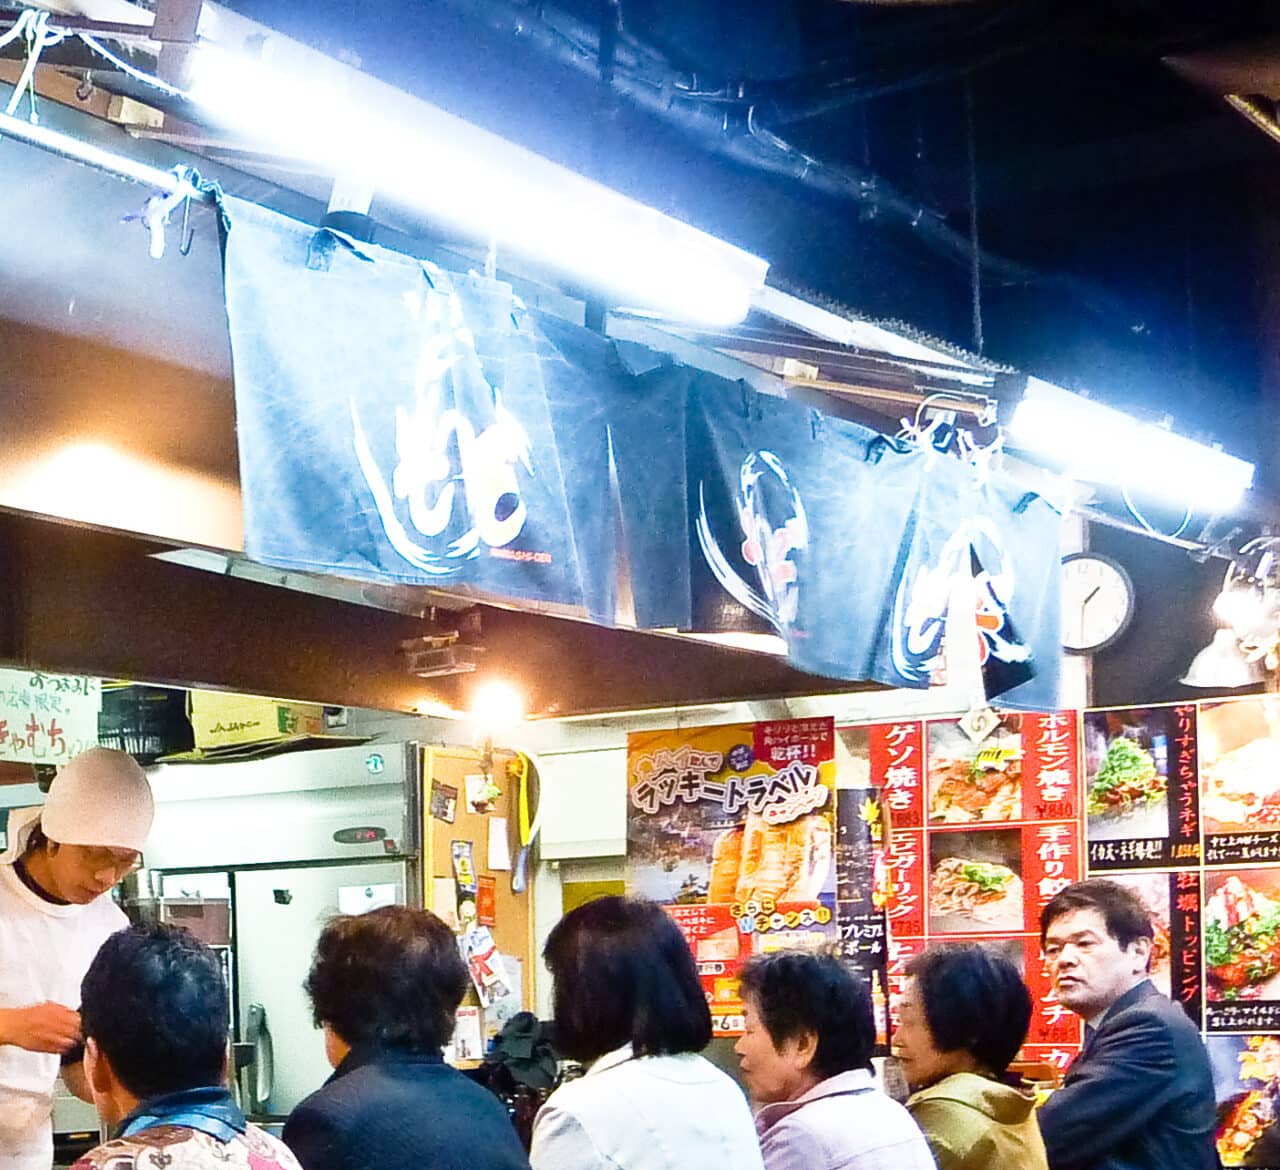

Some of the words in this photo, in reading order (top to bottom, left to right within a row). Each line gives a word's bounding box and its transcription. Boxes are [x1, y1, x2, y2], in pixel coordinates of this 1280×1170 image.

[638, 766, 811, 810] ラッキートラベル
[884, 724, 918, 810] ゲソ焼き
[1036, 715, 1072, 802] ホルモン焼き
[1174, 704, 1198, 838] やりすぎちゃうネギ
[887, 832, 918, 919] エビガーリック
[1176, 871, 1199, 1002] 牡蠣トッピング
